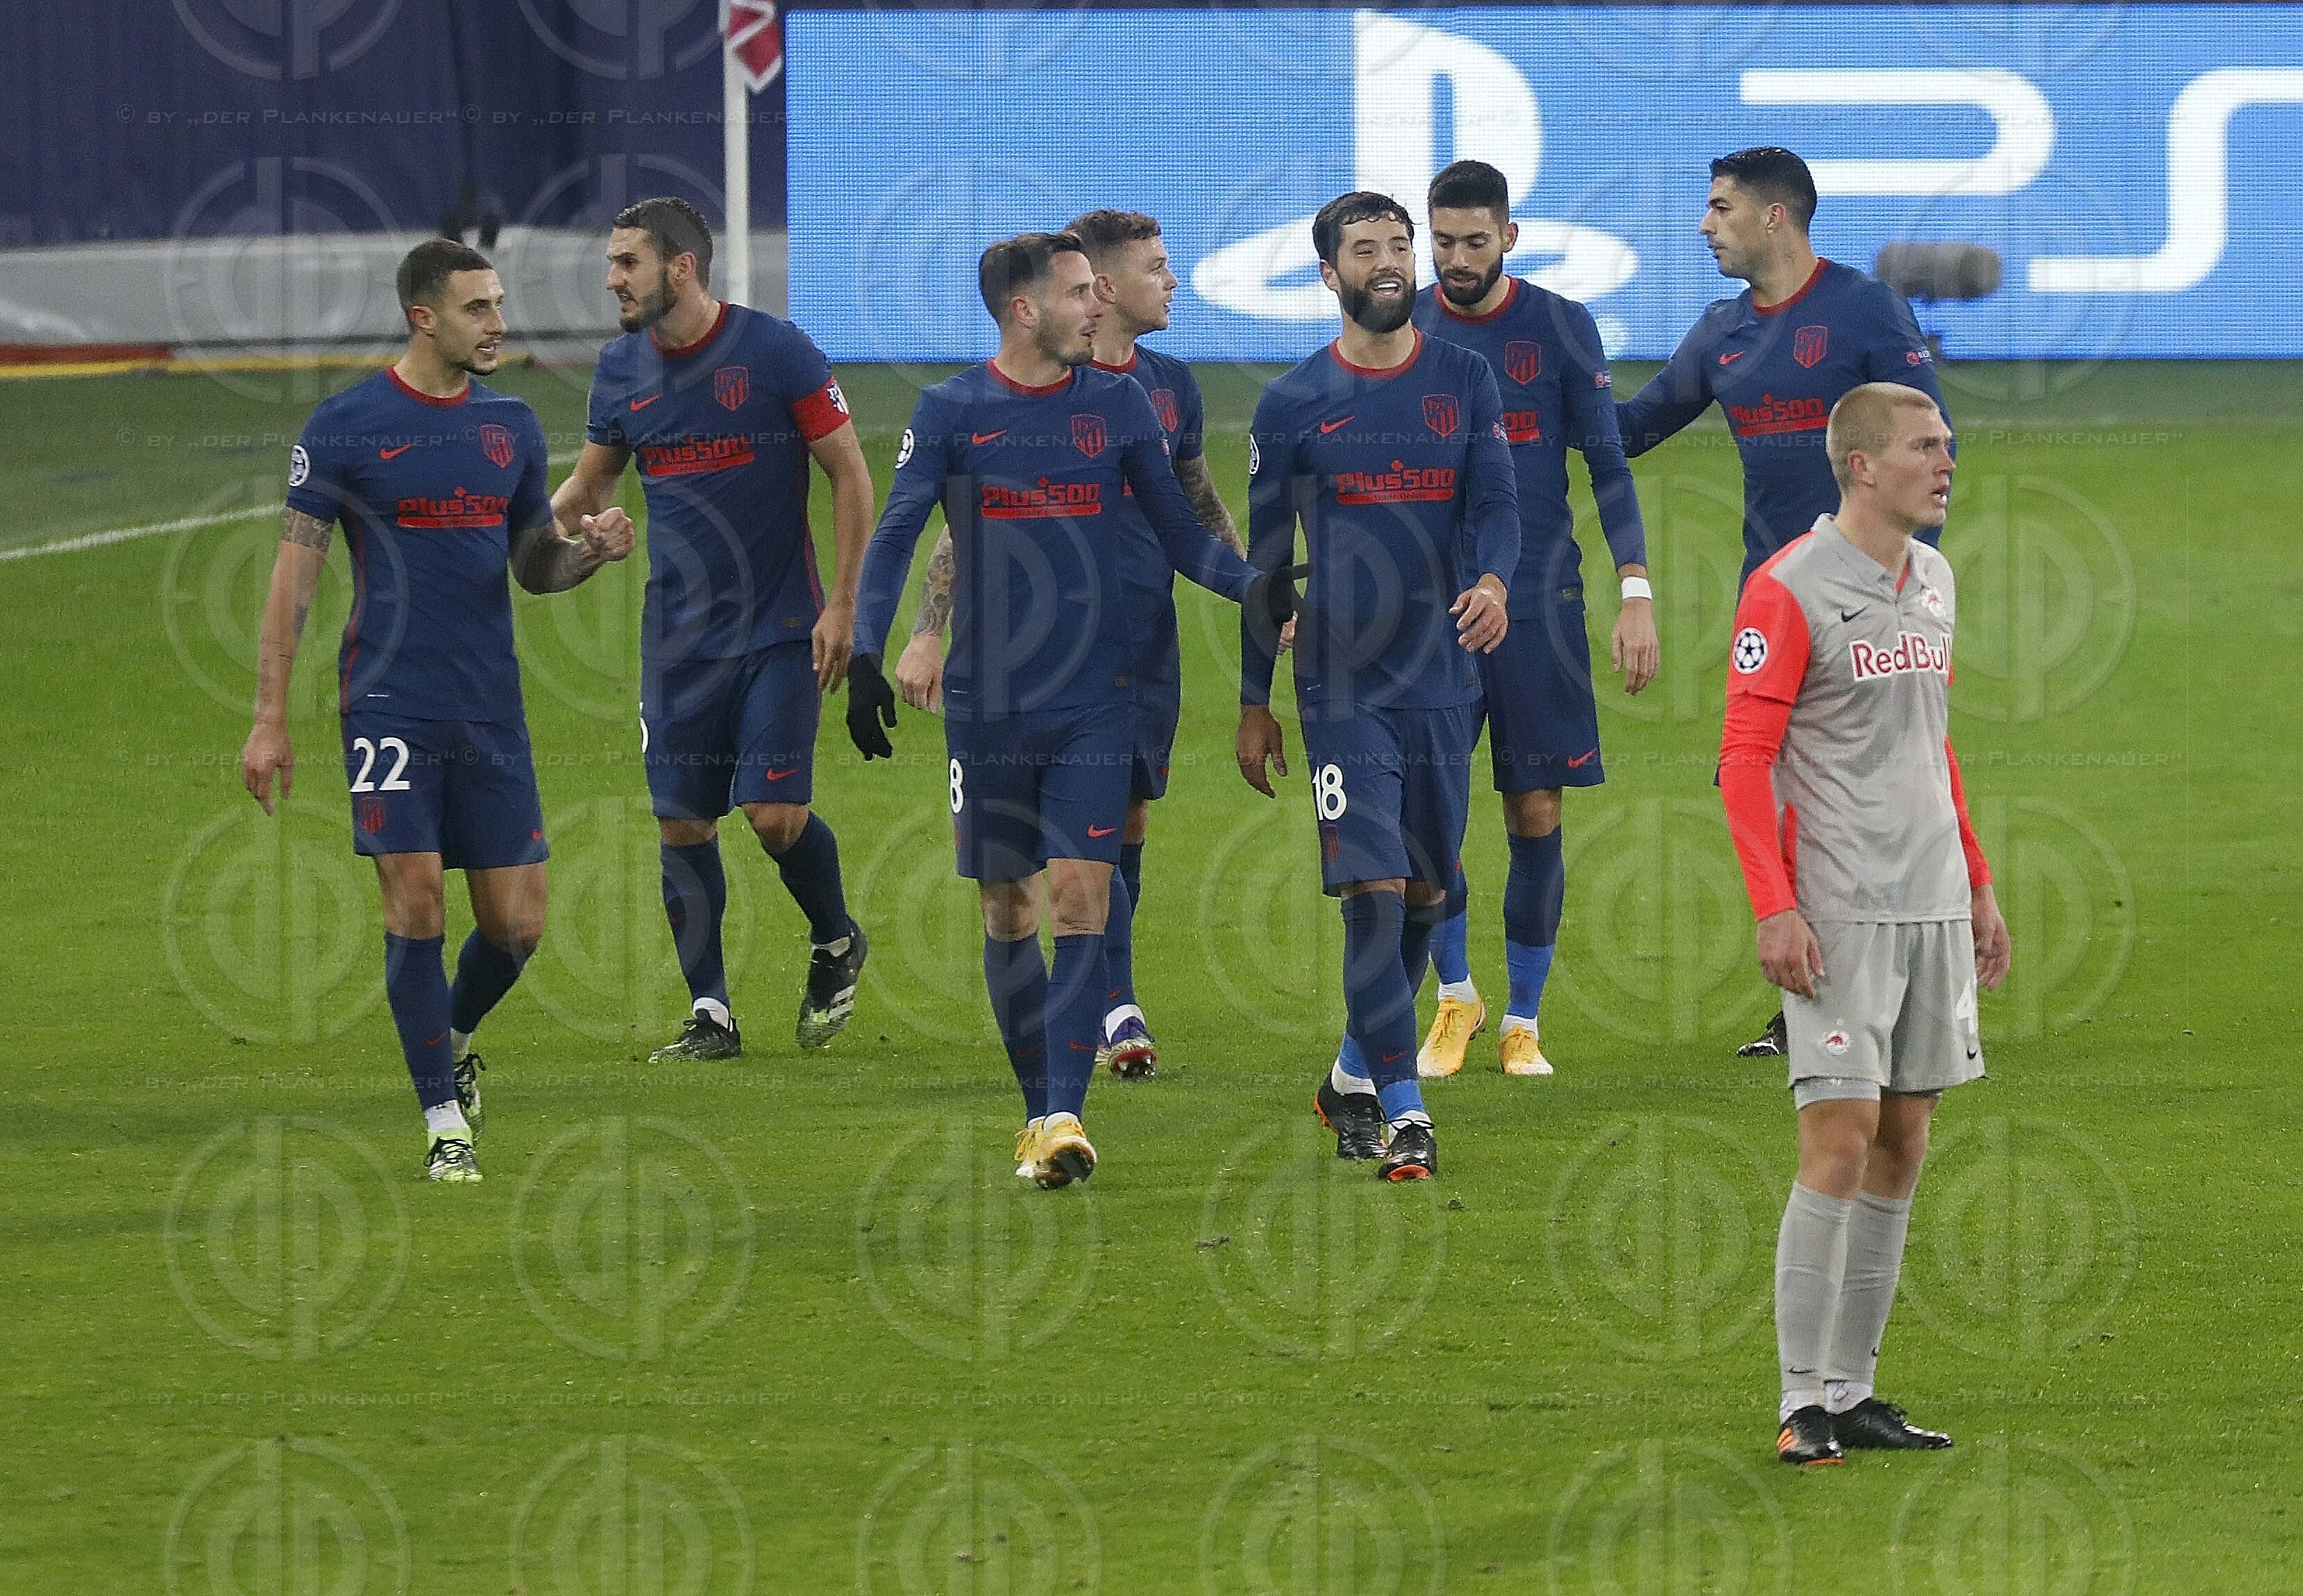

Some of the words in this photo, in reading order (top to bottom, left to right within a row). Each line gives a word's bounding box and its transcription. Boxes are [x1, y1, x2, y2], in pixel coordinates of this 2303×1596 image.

[981, 477, 1099, 505] Plus500
[1336, 460, 1455, 493] Plus500
[350, 737, 411, 792] 22
[950, 758, 964, 813] 8
[1312, 763, 1347, 820] 18
